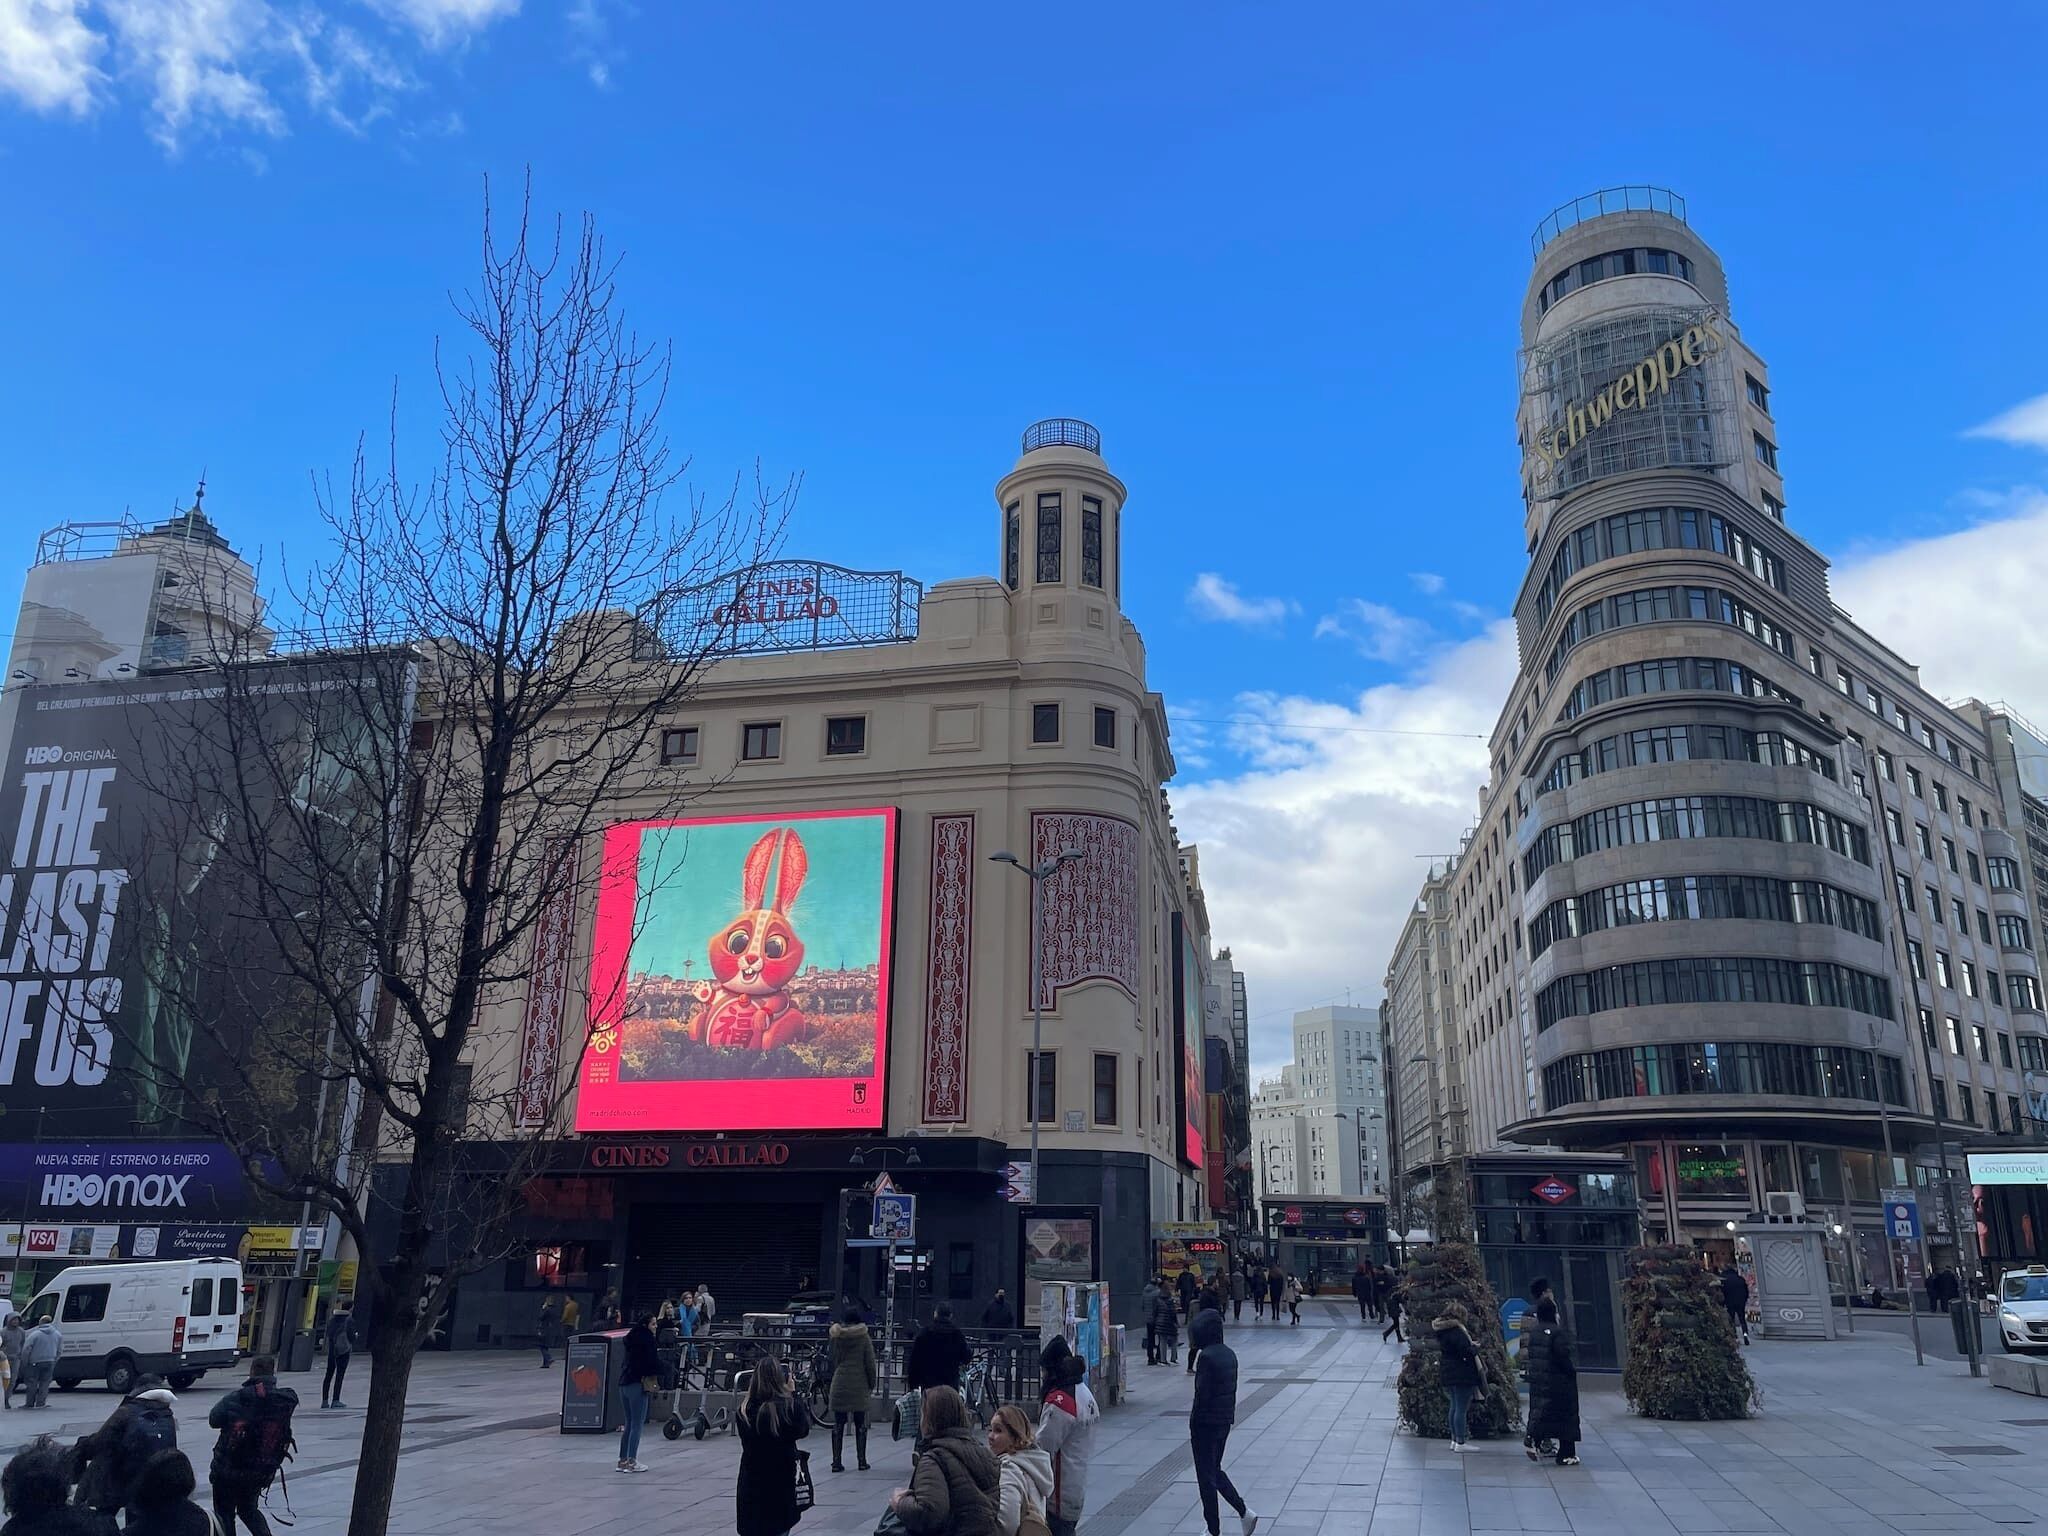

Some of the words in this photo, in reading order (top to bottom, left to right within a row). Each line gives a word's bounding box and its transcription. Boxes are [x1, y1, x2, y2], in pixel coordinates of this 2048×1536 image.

[1530, 312, 1726, 486] Schweppes
[738, 577, 815, 600] CINES
[711, 596, 838, 627] CALLAO
[36, 701, 49, 711] DEL
[25, 745, 64, 764] HBO
[63, 748, 117, 763] ORIGINAL
[12, 768, 116, 868] THE
[35, 976, 122, 1086] US
[714, 1006, 754, 1048] 福
[35, 1154, 69, 1166] NUEVA
[71, 1154, 100, 1166] SERIE
[109, 1154, 158, 1166] ESTRENO
[160, 1154, 171, 1166] 16
[173, 1154, 210, 1166] ENERO
[591, 1145, 670, 1168] CINES
[687, 1143, 790, 1167] CALLAO
[1979, 1166, 2046, 1175] CONDEDUQUE
[173, 1238, 227, 1251] Portuguesa
